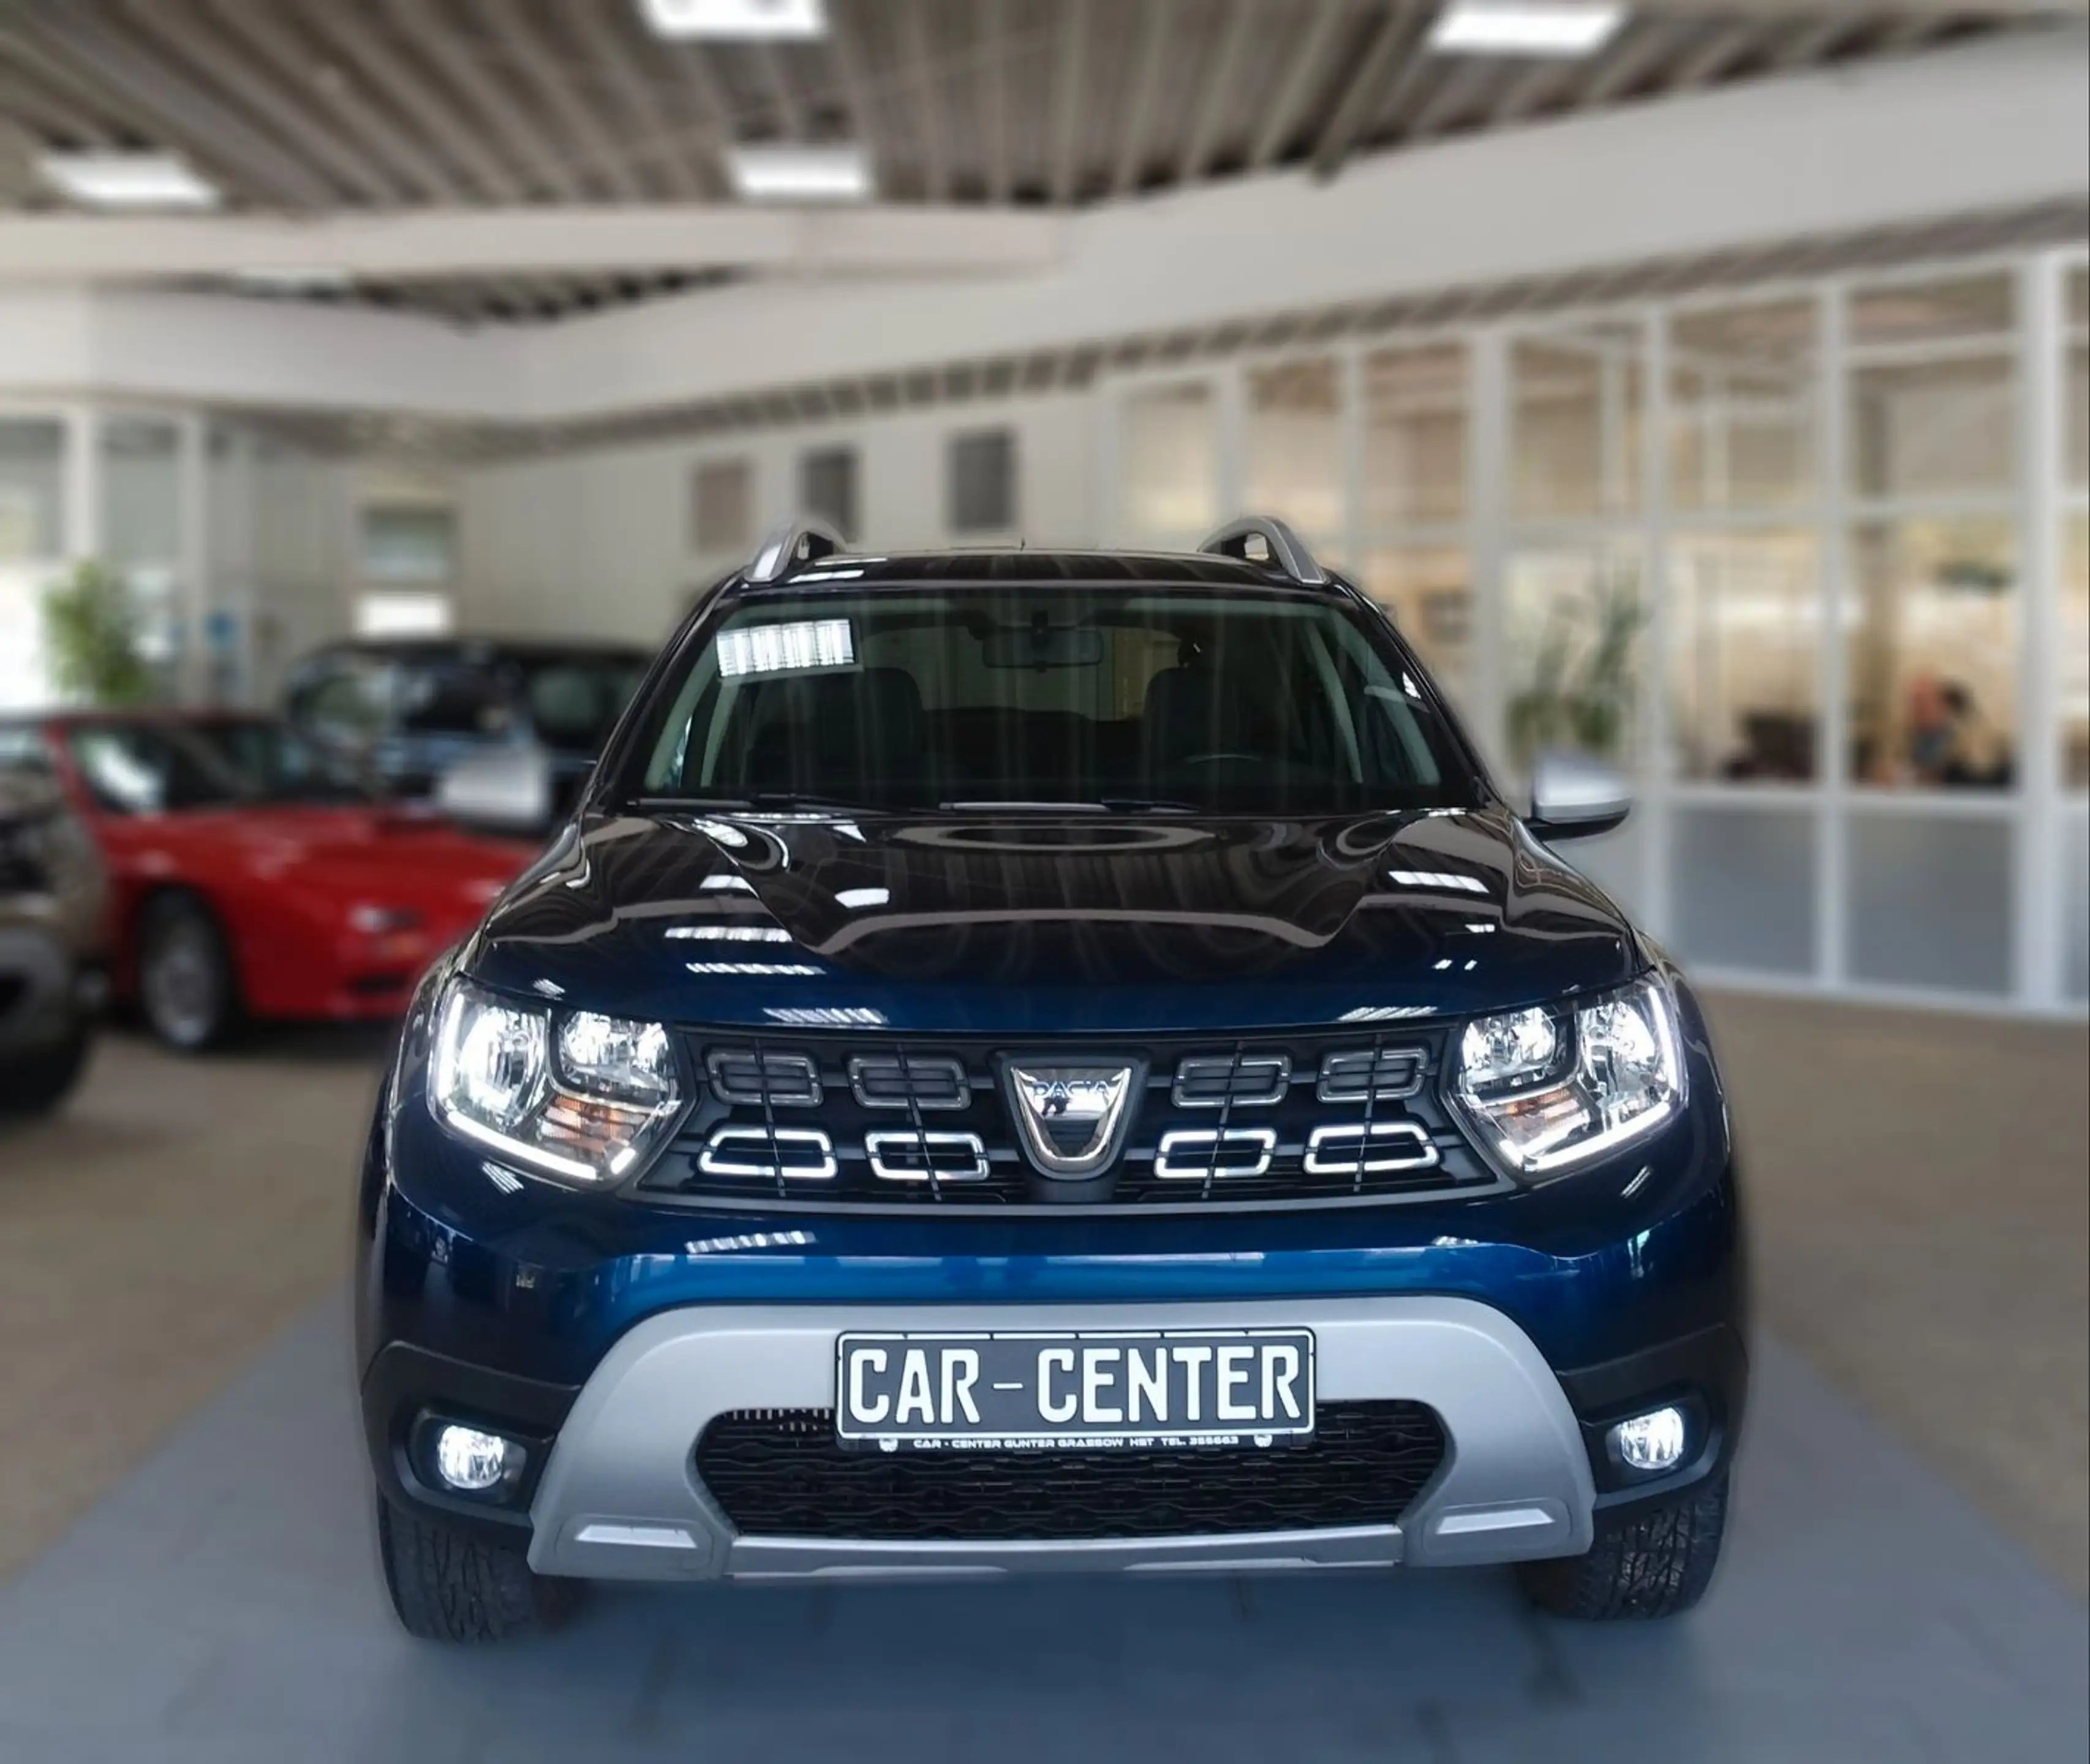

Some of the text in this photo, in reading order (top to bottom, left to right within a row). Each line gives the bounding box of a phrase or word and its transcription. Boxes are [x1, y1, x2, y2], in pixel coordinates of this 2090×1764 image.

[1032, 1080, 1110, 1099] DACIA
[850, 1349, 981, 1423] CAR
[1038, 1345, 1301, 1423] CENTER
[913, 1439, 941, 1449] CAR
[951, 1439, 1001, 1449] CENTER
